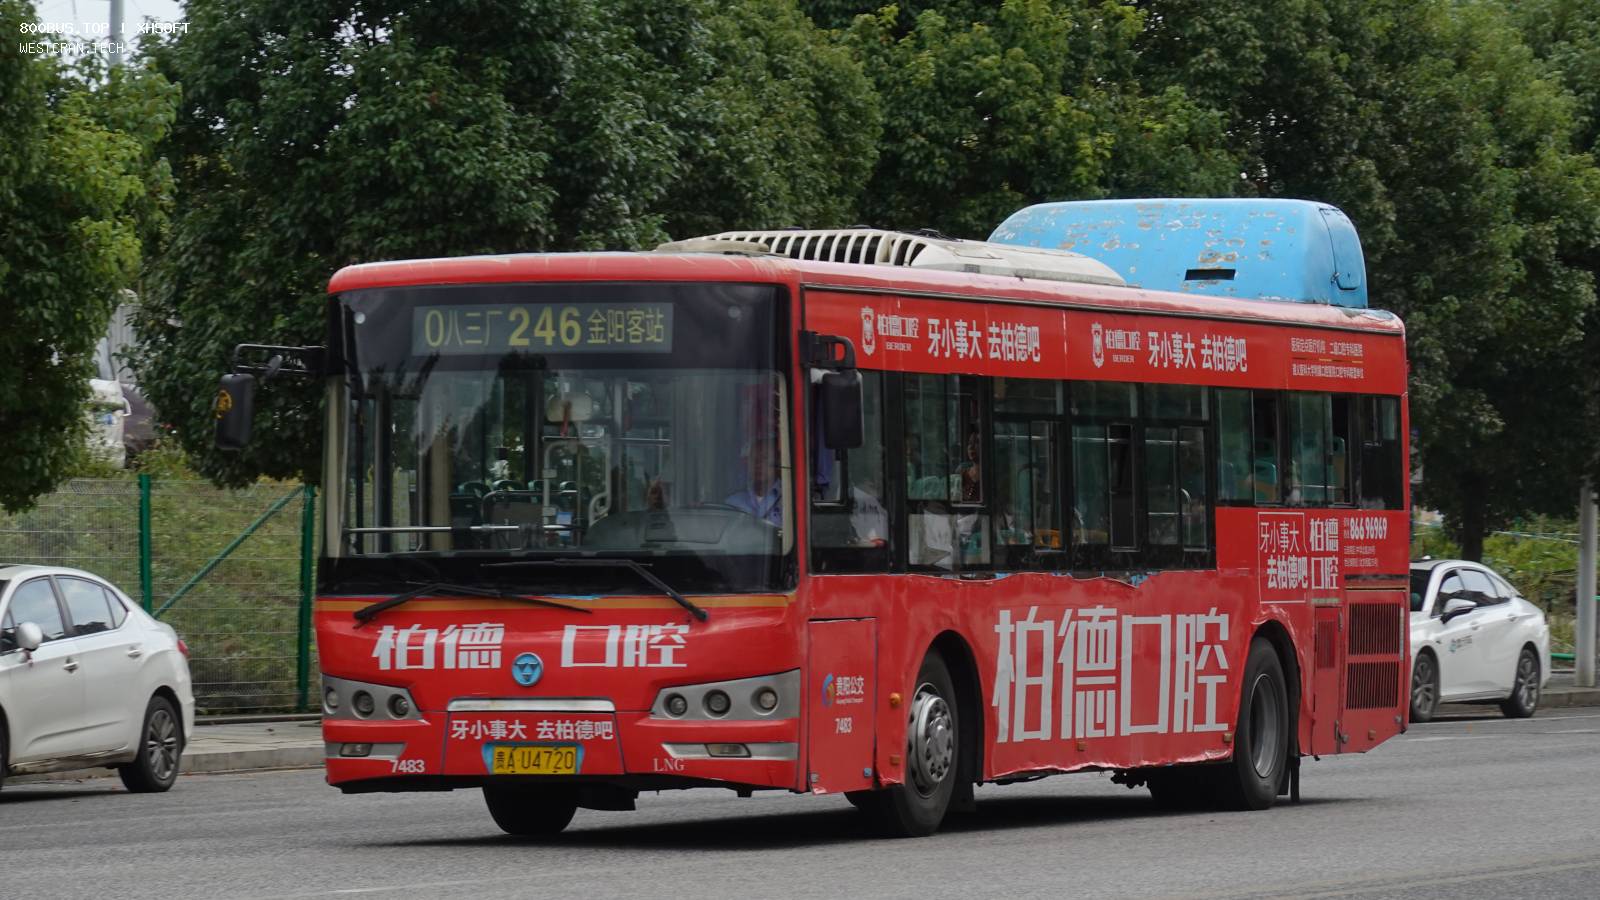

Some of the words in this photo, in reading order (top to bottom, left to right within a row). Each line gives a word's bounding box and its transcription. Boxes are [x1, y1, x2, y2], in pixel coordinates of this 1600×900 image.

[508, 306, 582, 347] 246
[586, 308, 665, 345] 金阳客站
[877, 314, 919, 338] 柏德口腔
[927, 318, 983, 359] 牙小事大
[988, 321, 1041, 362] 去柏德吧
[1105, 329, 1141, 350] 柏德口腔
[1147, 331, 1196, 369] 牙小事大
[1201, 334, 1248, 372] 去柏德吧
[1260, 520, 1300, 553] 牙小事大
[1309, 517, 1339, 552] 柏德
[1267, 555, 1308, 589] 去柏德吧
[1311, 555, 1340, 590] 口腔
[371, 622, 505, 670] 柏德
[561, 622, 691, 668] 口腔
[991, 605, 1230, 743] 柏德口腔
[451, 719, 527, 741] 牙小事大
[537, 720, 614, 741] 去柏德吧
[835, 717, 852, 734] 7483
[390, 759, 426, 774] 7483
[653, 757, 685, 772] LNG
